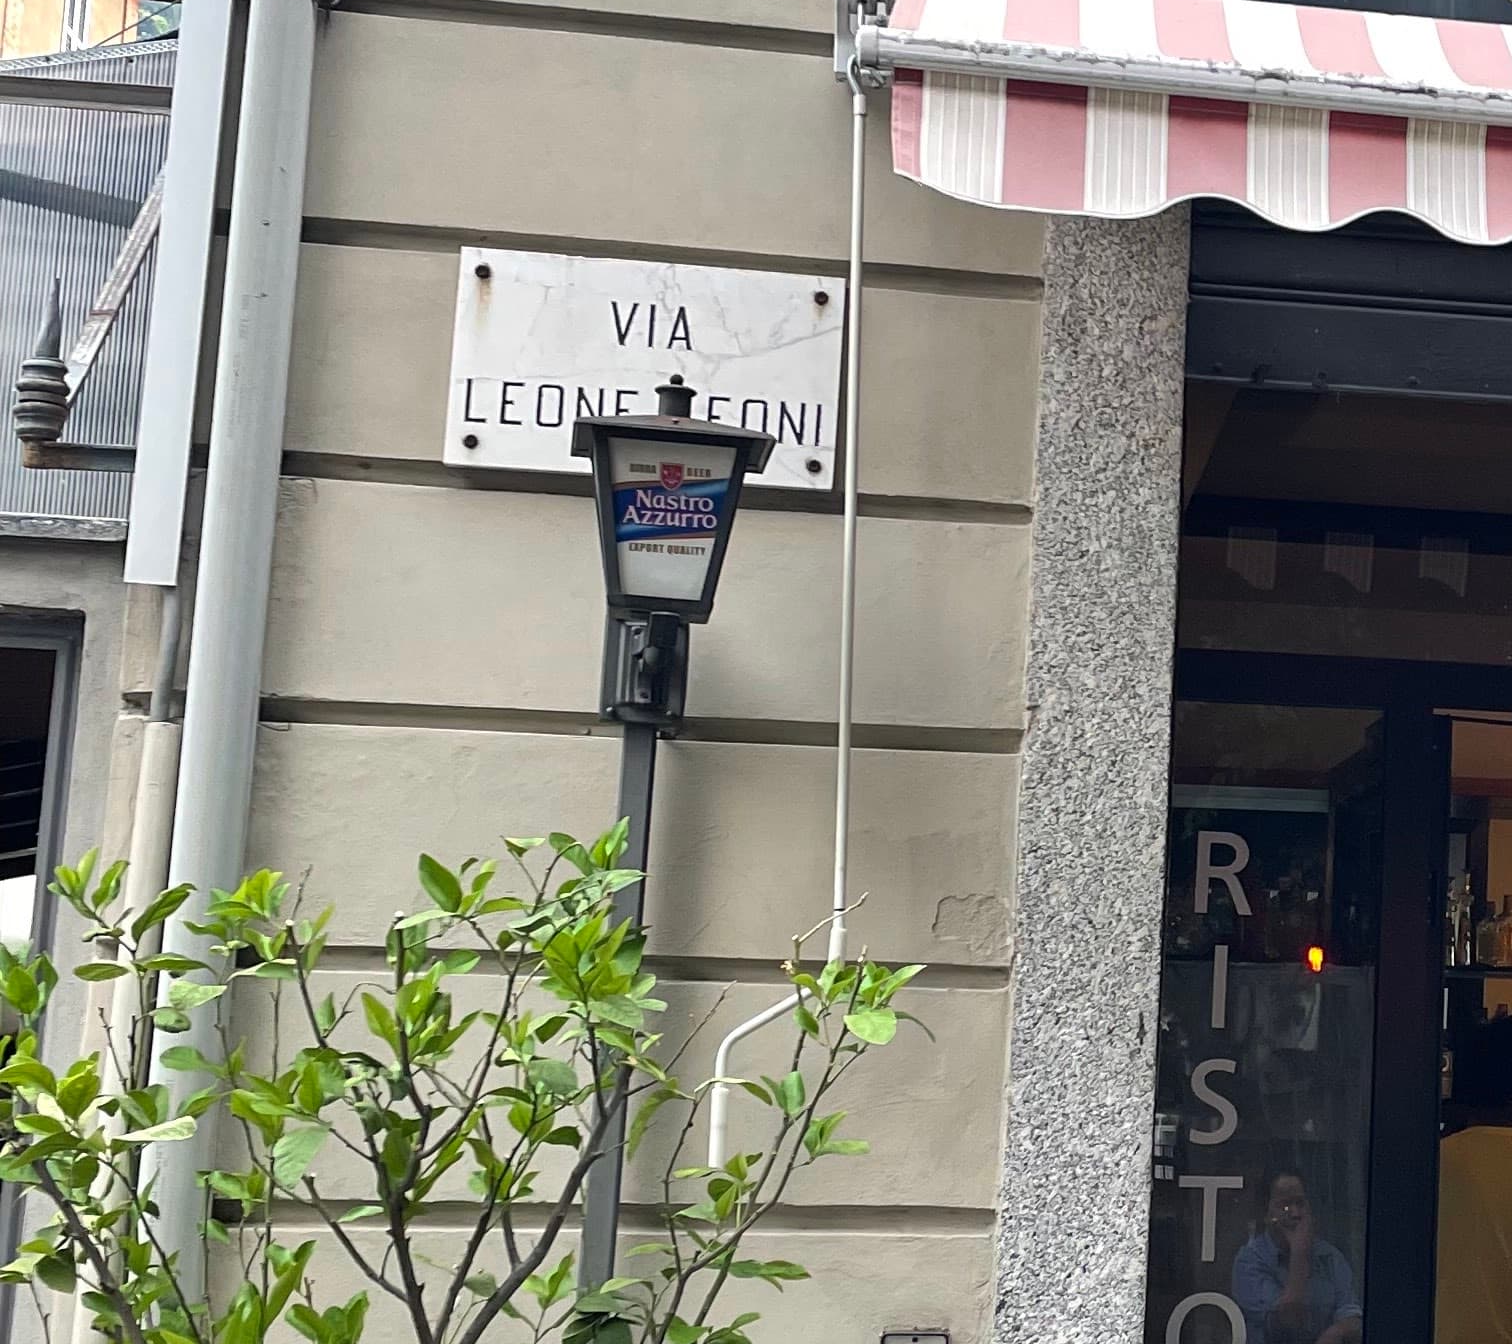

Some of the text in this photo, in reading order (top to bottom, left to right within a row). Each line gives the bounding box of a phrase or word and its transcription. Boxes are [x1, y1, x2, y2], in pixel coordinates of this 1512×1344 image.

[610, 300, 694, 352] VIA
[463, 377, 824, 447] LEONE EONI
[635, 488, 715, 513] Nastro
[621, 505, 719, 530] Azzurro
[627, 542, 707, 557] EXPORT QUALITY
